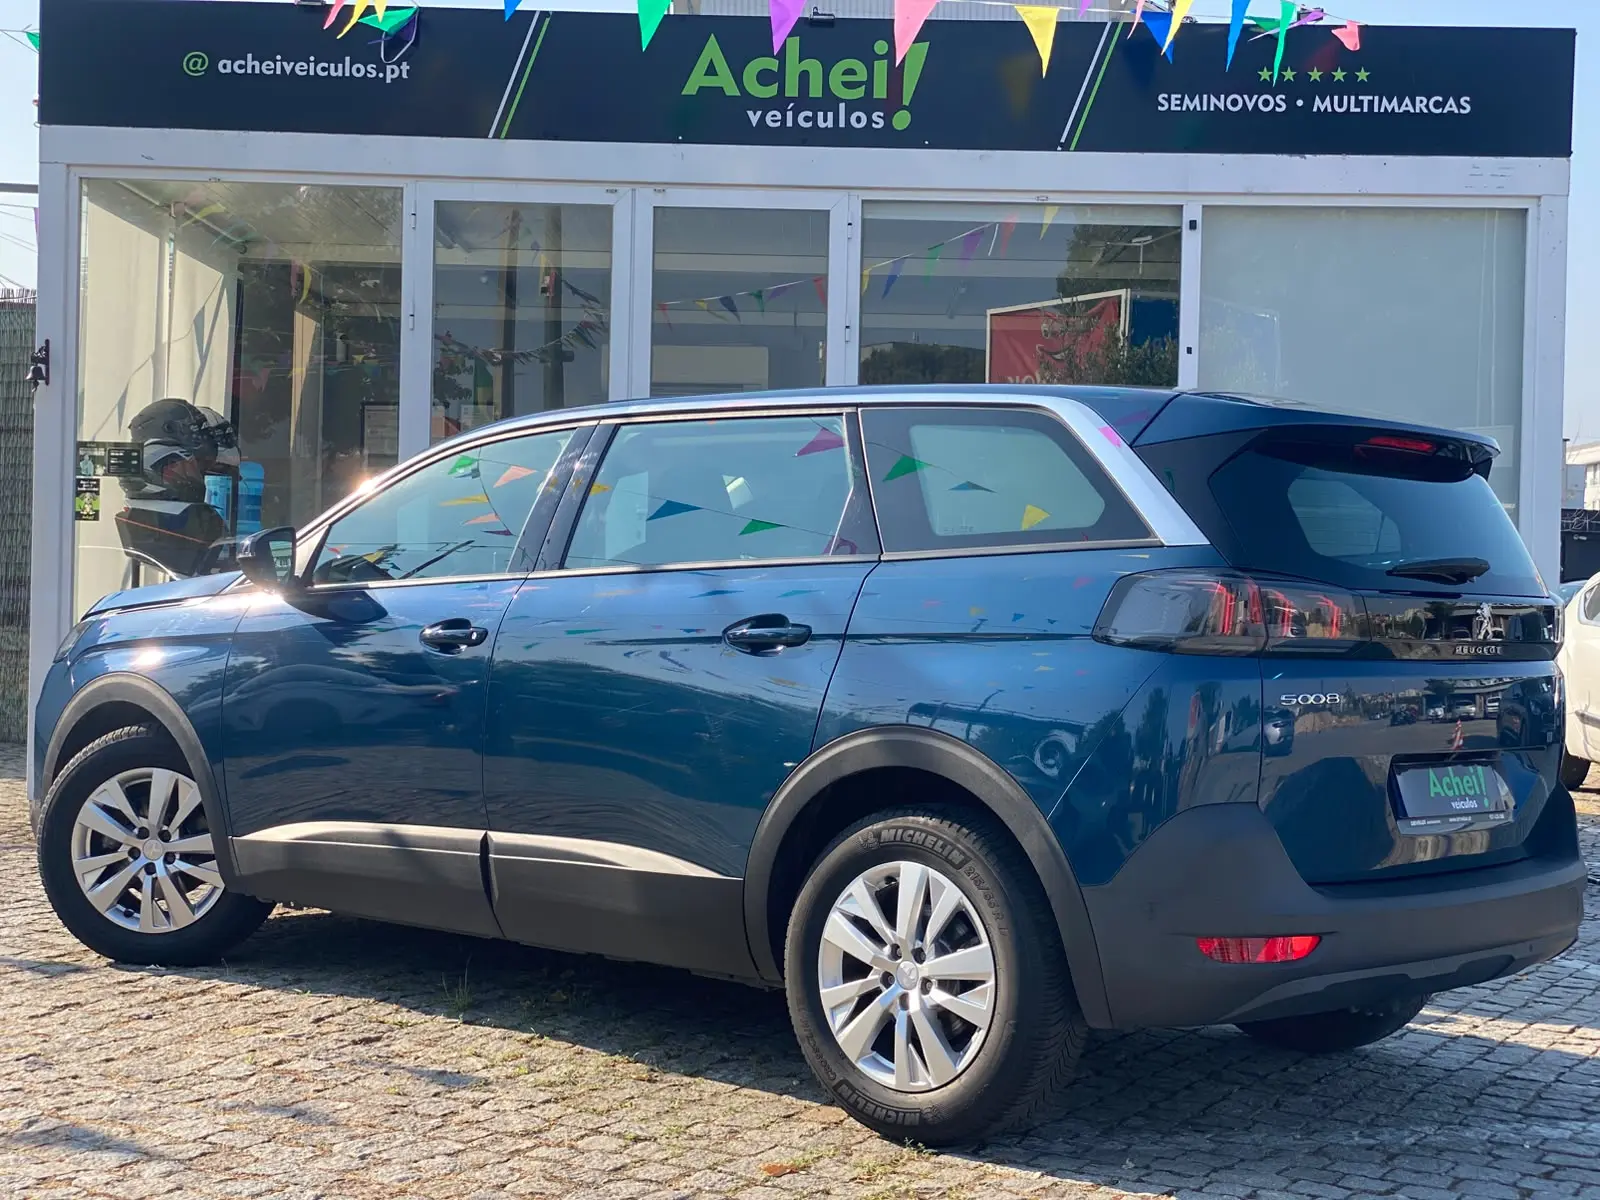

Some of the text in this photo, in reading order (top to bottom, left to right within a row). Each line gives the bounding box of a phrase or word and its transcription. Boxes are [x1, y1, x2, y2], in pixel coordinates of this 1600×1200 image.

[183, 52, 410, 83] @ acheiveiculos.pt
[681, 33, 930, 131] Achei!
[746, 102, 885, 129] veículos
[1157, 93, 1472, 114] SEMINOVOS MULTIMARCAS
[1455, 645, 1502, 656] PEUGEOT
[1280, 692, 1340, 706] 5008
[1428, 765, 1489, 808] Achei!
[880, 828, 967, 866] MICHELIN
[837, 1083, 921, 1127] MICHELIN
